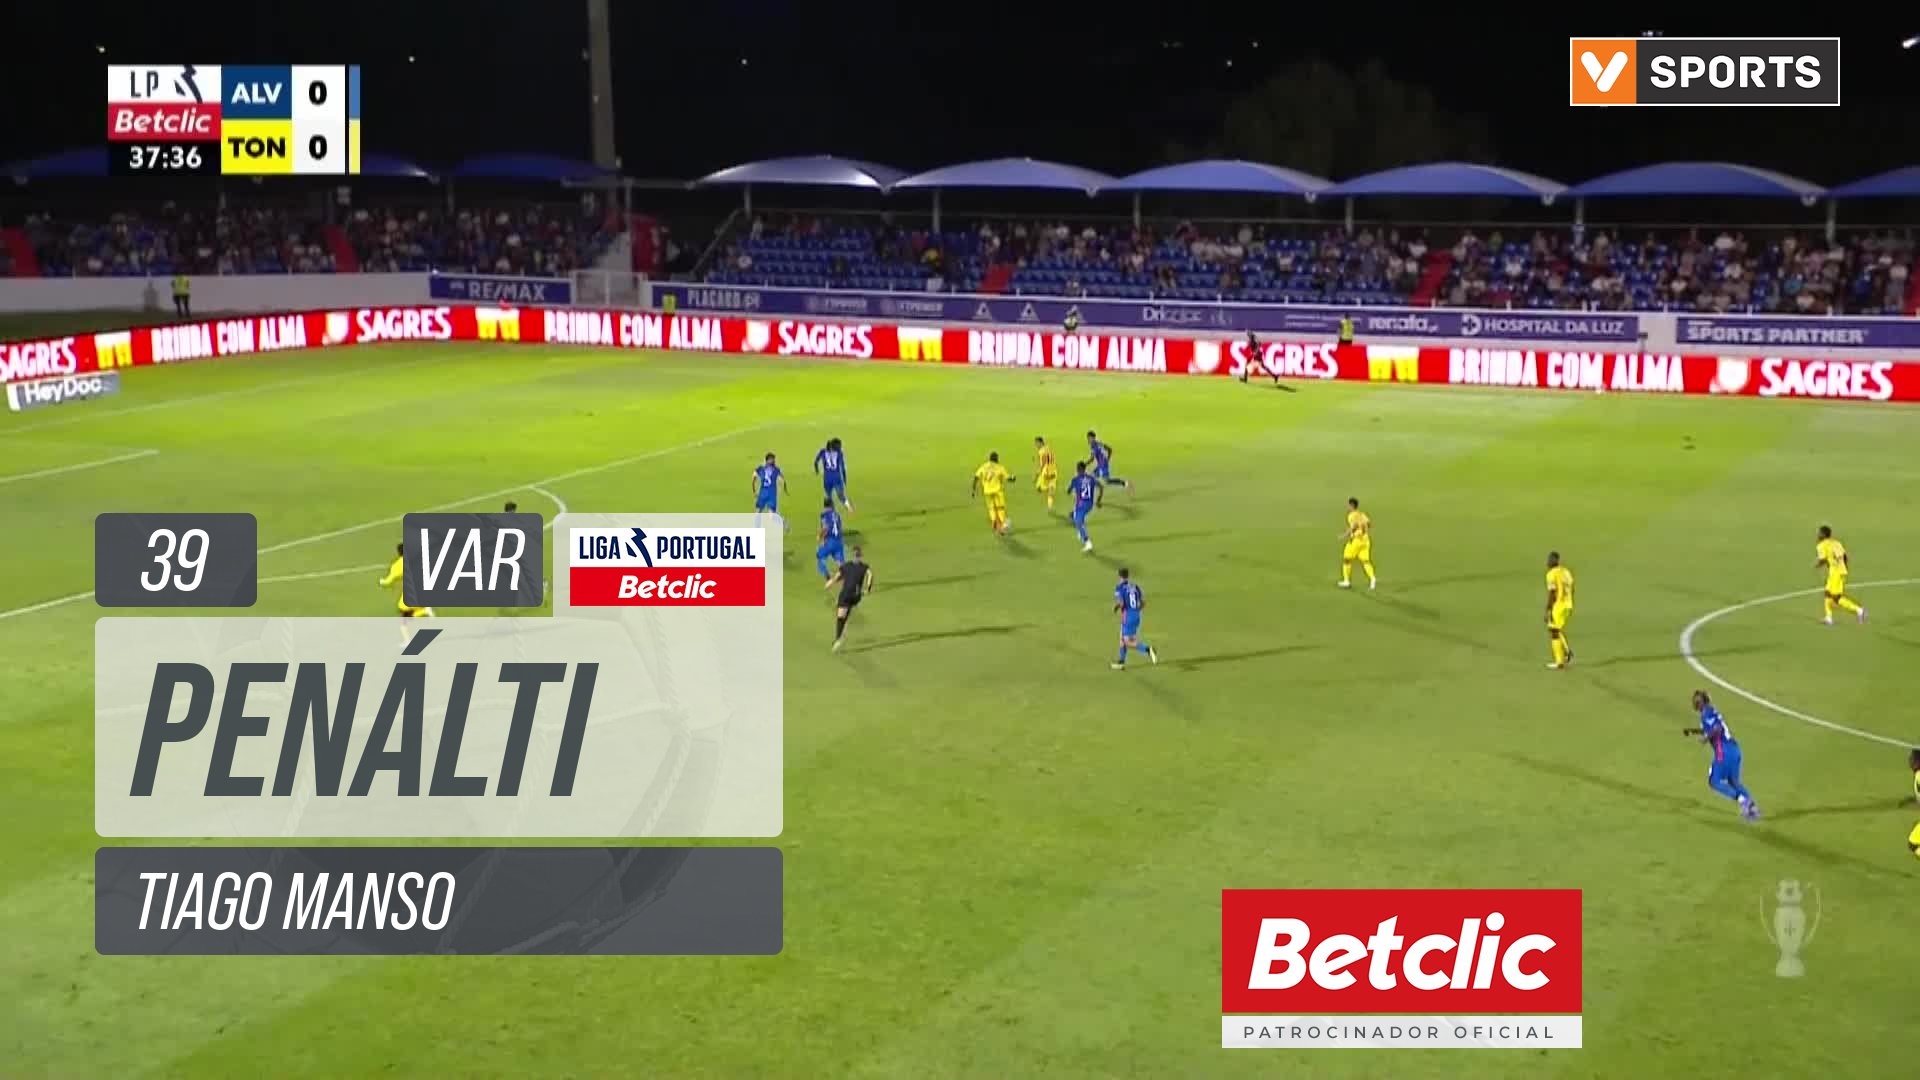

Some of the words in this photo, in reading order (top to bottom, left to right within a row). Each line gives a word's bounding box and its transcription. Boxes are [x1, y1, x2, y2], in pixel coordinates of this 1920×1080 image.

[468, 281, 545, 301] RE/MAX
[216, 320, 255, 354] COM
[259, 315, 307, 349] ALMA
[356, 307, 452, 341] SAGRES
[619, 314, 662, 348] COM
[669, 317, 723, 350] ALMA
[778, 320, 873, 358] SAGRES
[1484, 318, 1562, 334] HOSPITAL
[1565, 321, 1588, 334] DA
[1592, 321, 1625, 335] LUZ
[1687, 325, 1763, 341] SPORTS
[1051, 334, 1100, 368] COM
[1106, 336, 1167, 371] ALMA
[1547, 352, 1603, 388] COM
[1610, 354, 1684, 392] ALMA
[1758, 358, 1894, 400] SAGRES
